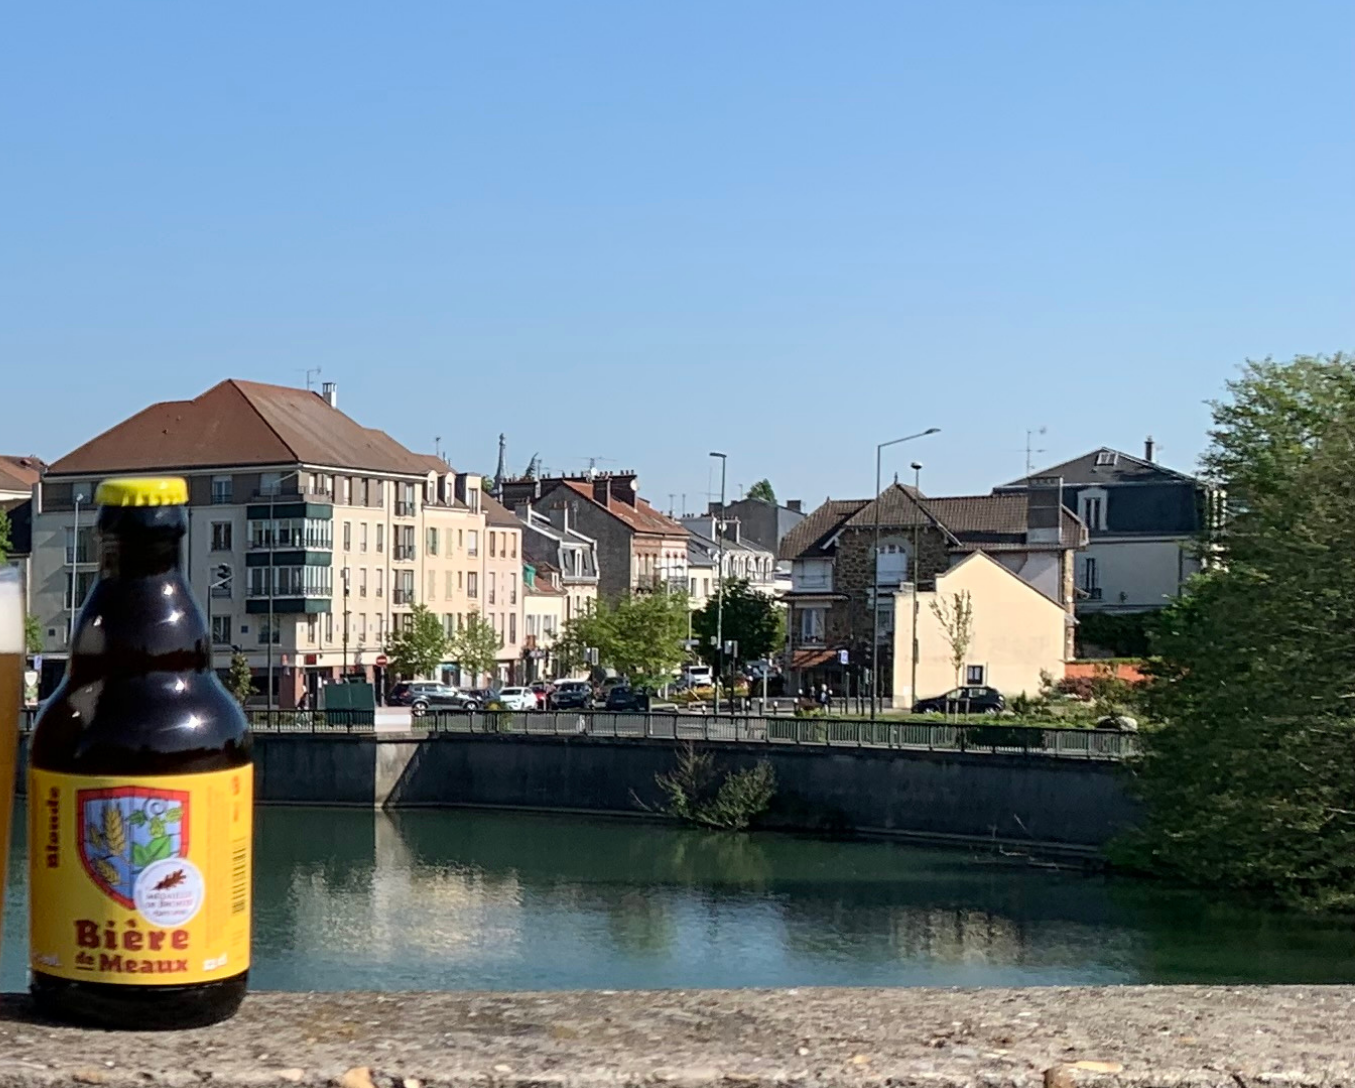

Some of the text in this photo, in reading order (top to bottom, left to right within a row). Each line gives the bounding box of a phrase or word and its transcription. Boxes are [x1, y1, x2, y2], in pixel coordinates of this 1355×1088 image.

[46, 786, 60, 869] Blonde
[75, 918, 189, 951] Bière
[75, 951, 95, 966] de
[99, 953, 188, 974] Meaux
